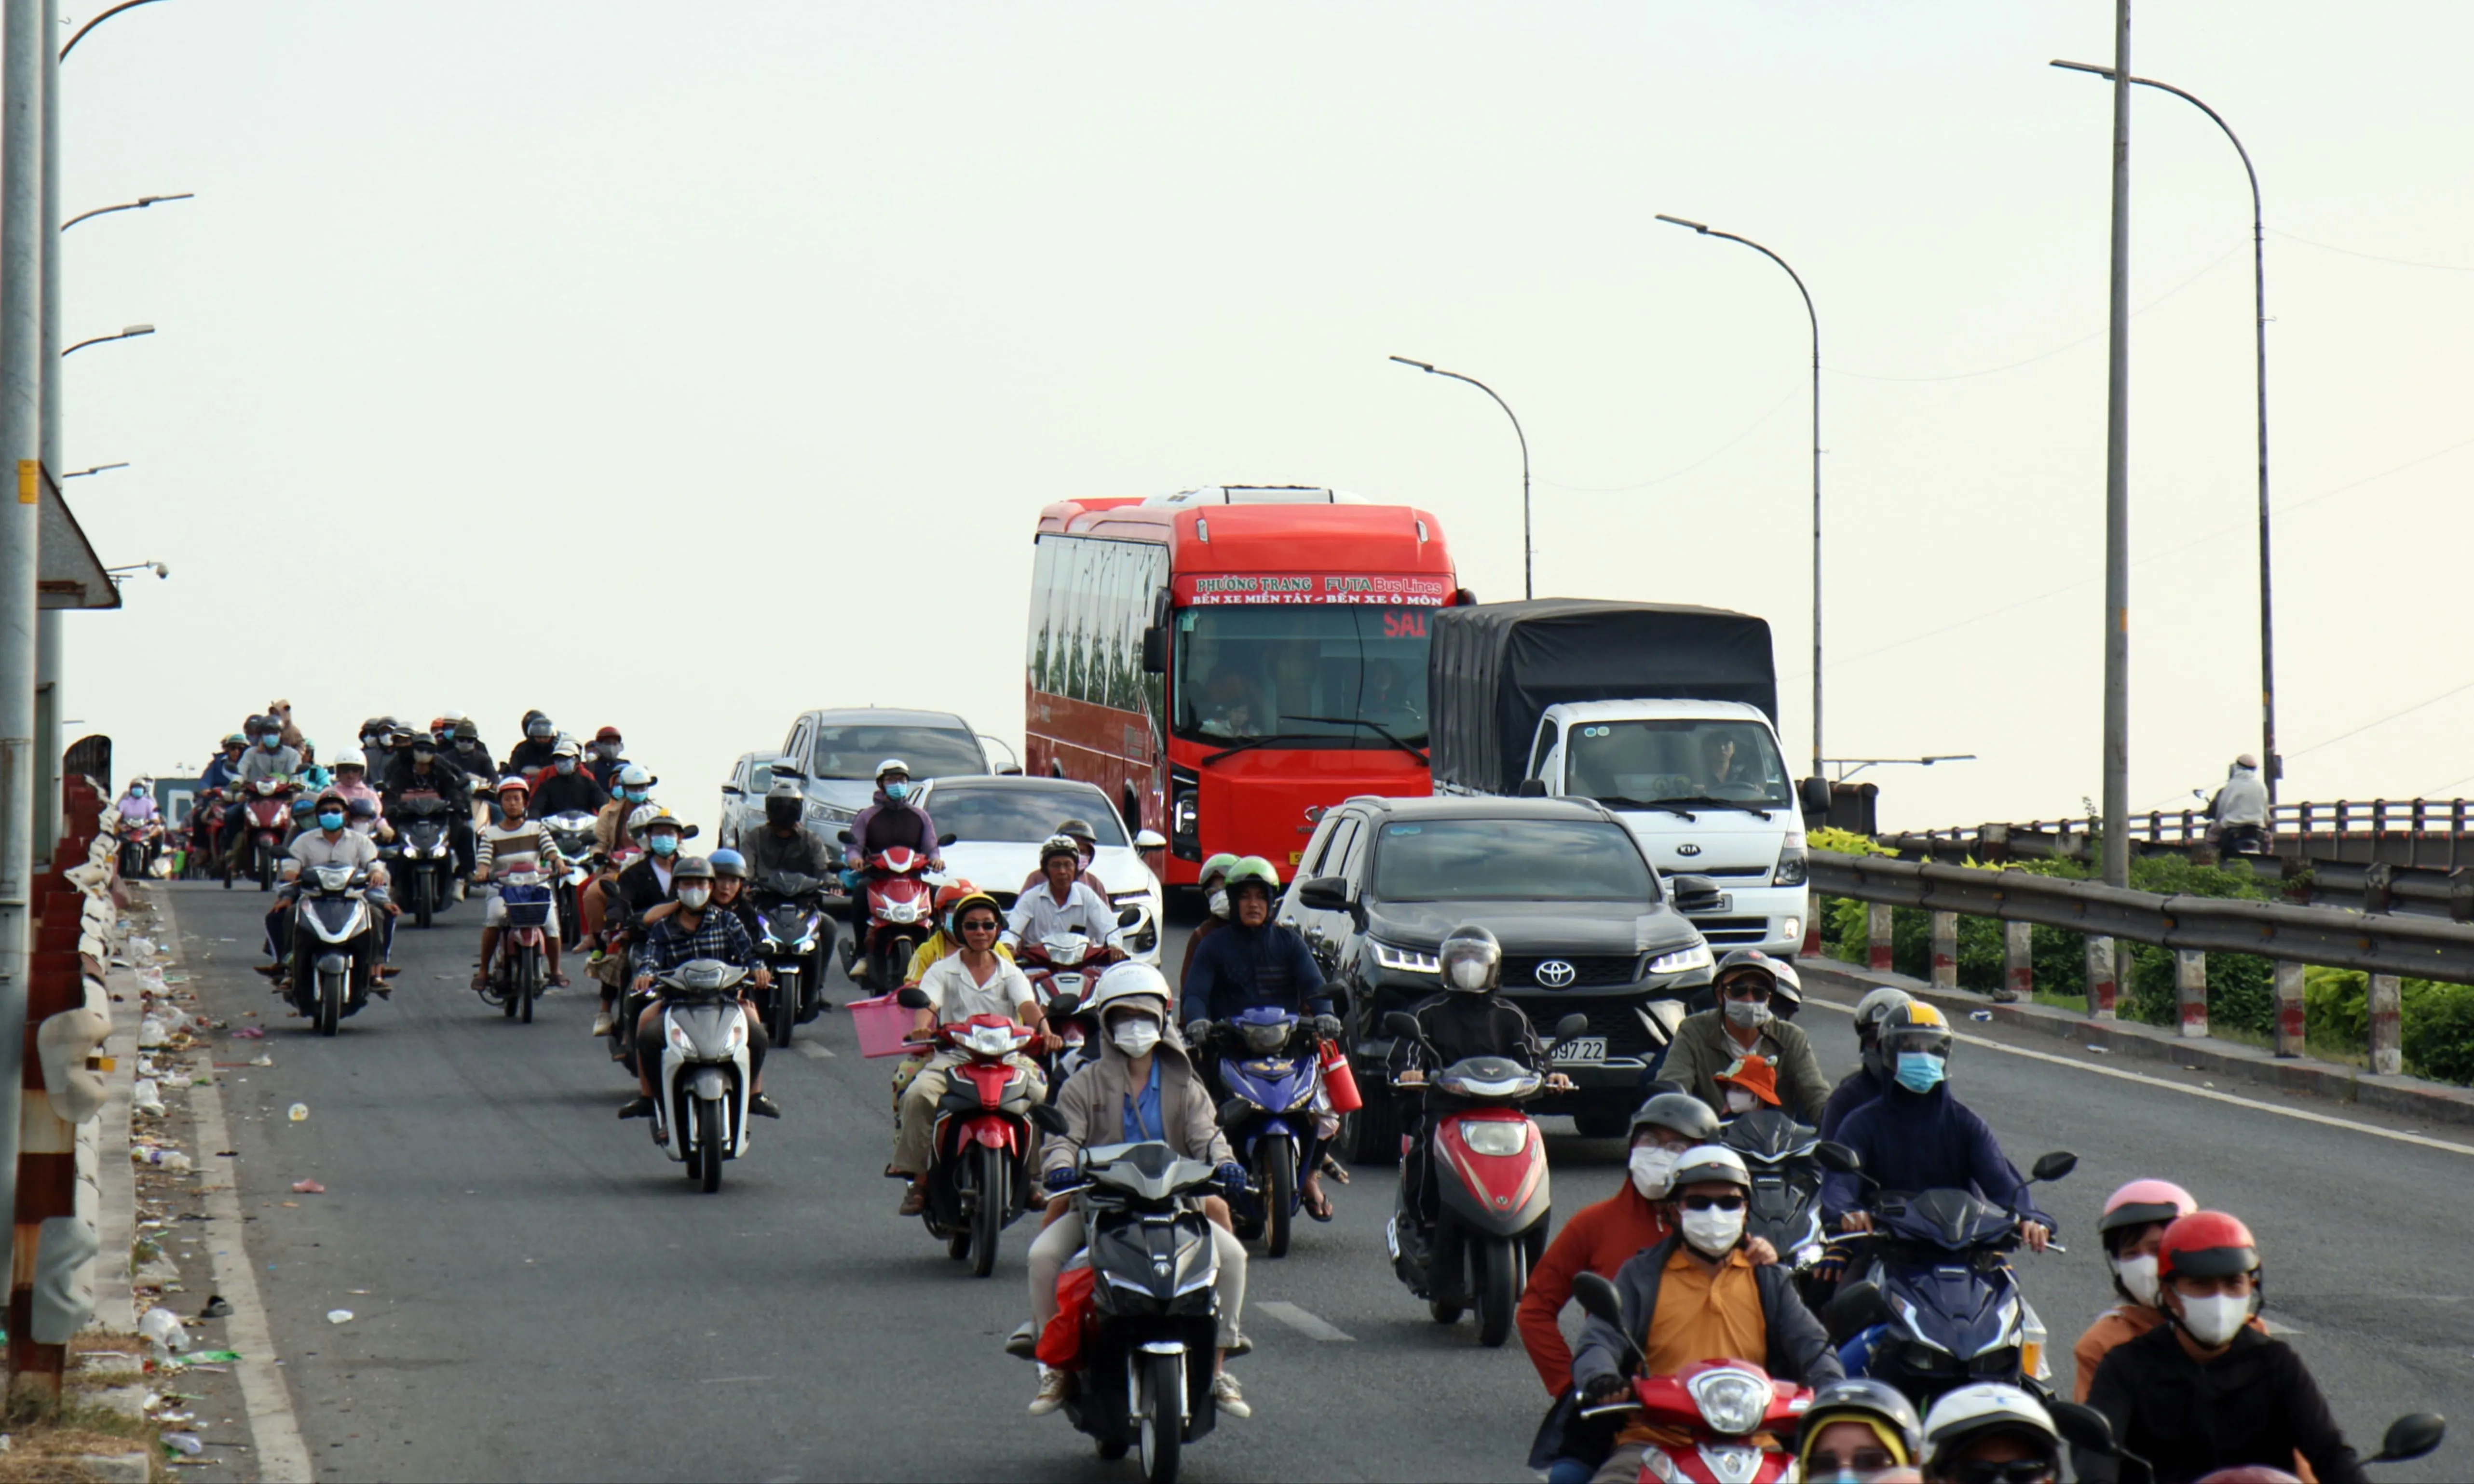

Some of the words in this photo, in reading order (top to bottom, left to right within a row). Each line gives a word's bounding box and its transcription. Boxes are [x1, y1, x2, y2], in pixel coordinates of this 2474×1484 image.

[1196, 575, 1257, 592] PHƯƠNG
[1260, 577, 1312, 592] TRANG
[1325, 577, 1372, 592] FUTA
[1375, 577, 1403, 593] Bus
[1403, 578, 1442, 594] Lines
[1193, 592, 1220, 604] BẾN
[1223, 594, 1242, 603] XE
[1284, 593, 1313, 604] TÂY
[1326, 592, 1359, 604] BẾN
[1364, 595, 1387, 604] XE
[1391, 594, 1402, 605] Ô
[1407, 594, 1442, 606] MÔN
